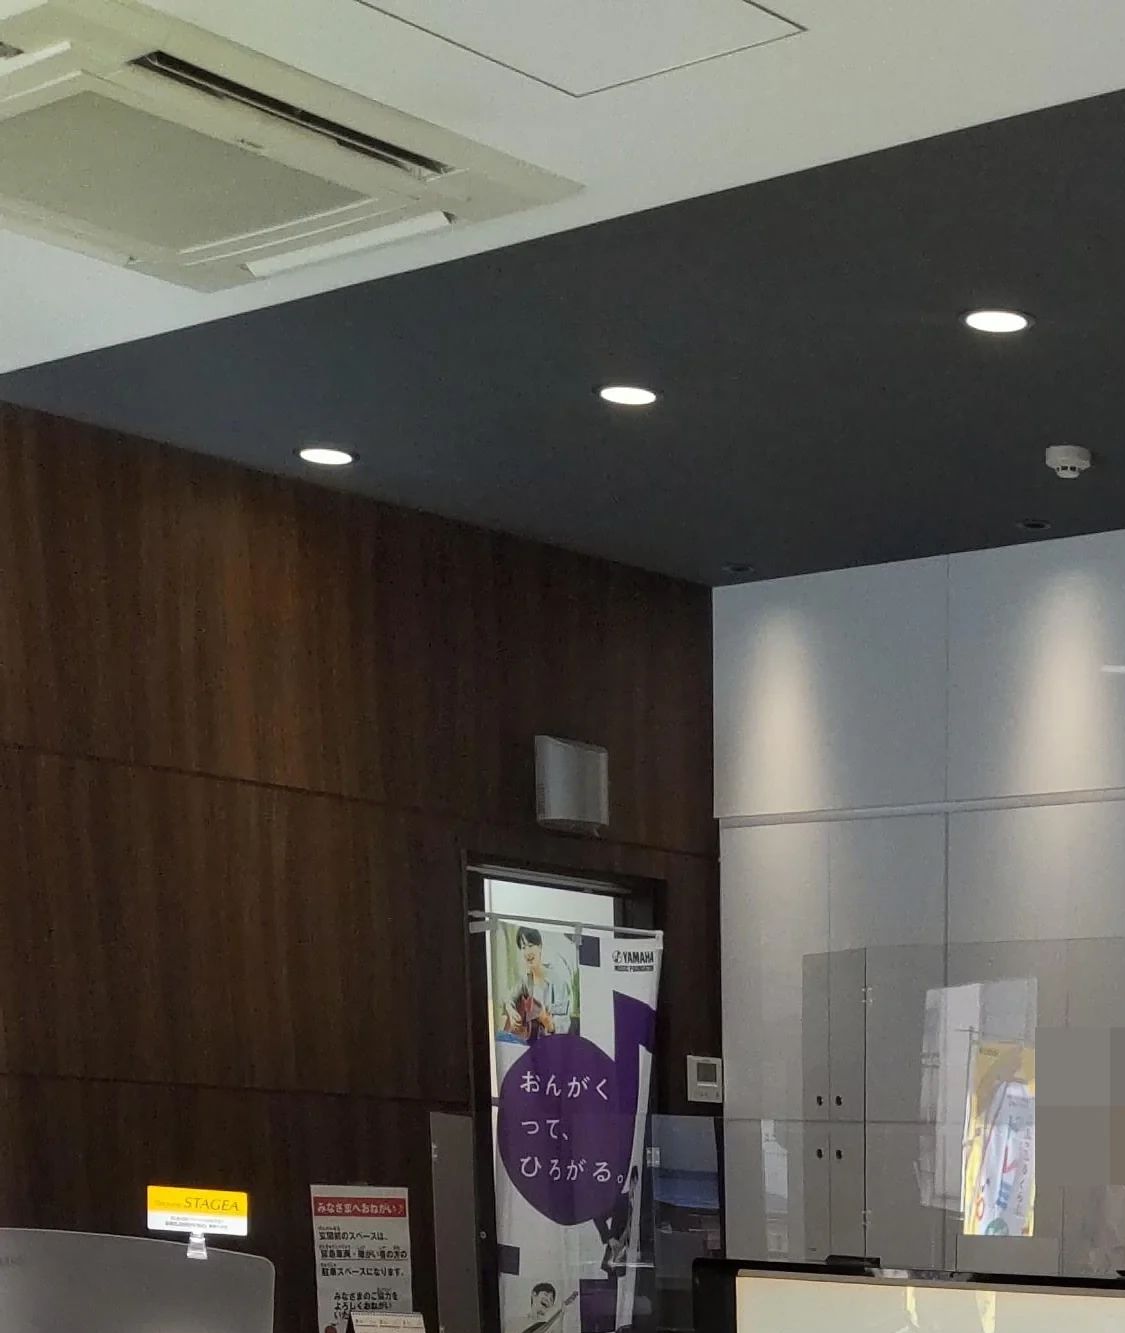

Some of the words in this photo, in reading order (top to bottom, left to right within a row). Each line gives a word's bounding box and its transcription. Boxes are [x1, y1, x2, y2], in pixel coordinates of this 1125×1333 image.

[622, 951, 654, 963] YAMAHA
[520, 1071, 608, 1100] おんがく
[520, 1156, 624, 1184] ひろがる。
[184, 1197, 239, 1212] STAGEA
